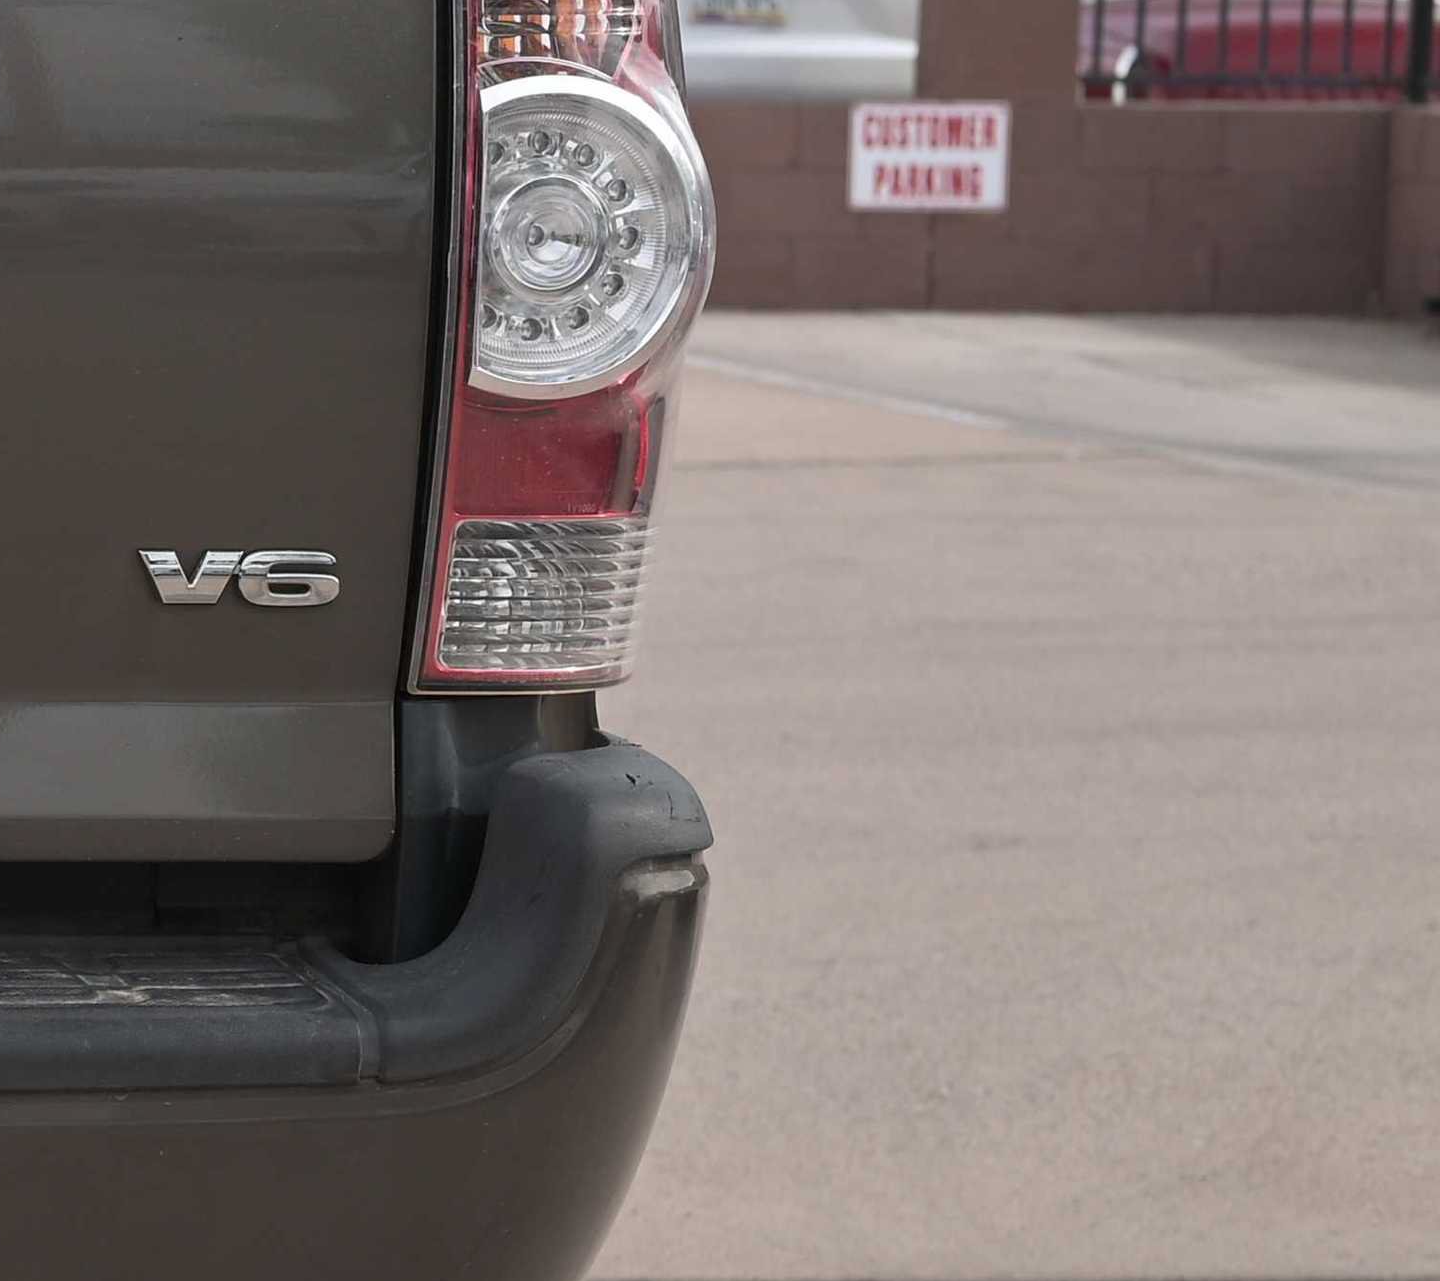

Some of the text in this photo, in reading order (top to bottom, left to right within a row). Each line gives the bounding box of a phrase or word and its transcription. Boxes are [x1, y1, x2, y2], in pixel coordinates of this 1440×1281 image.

[862, 114, 997, 149] CUSTOMER
[874, 164, 983, 198] PARKING
[137, 549, 341, 607] V6
